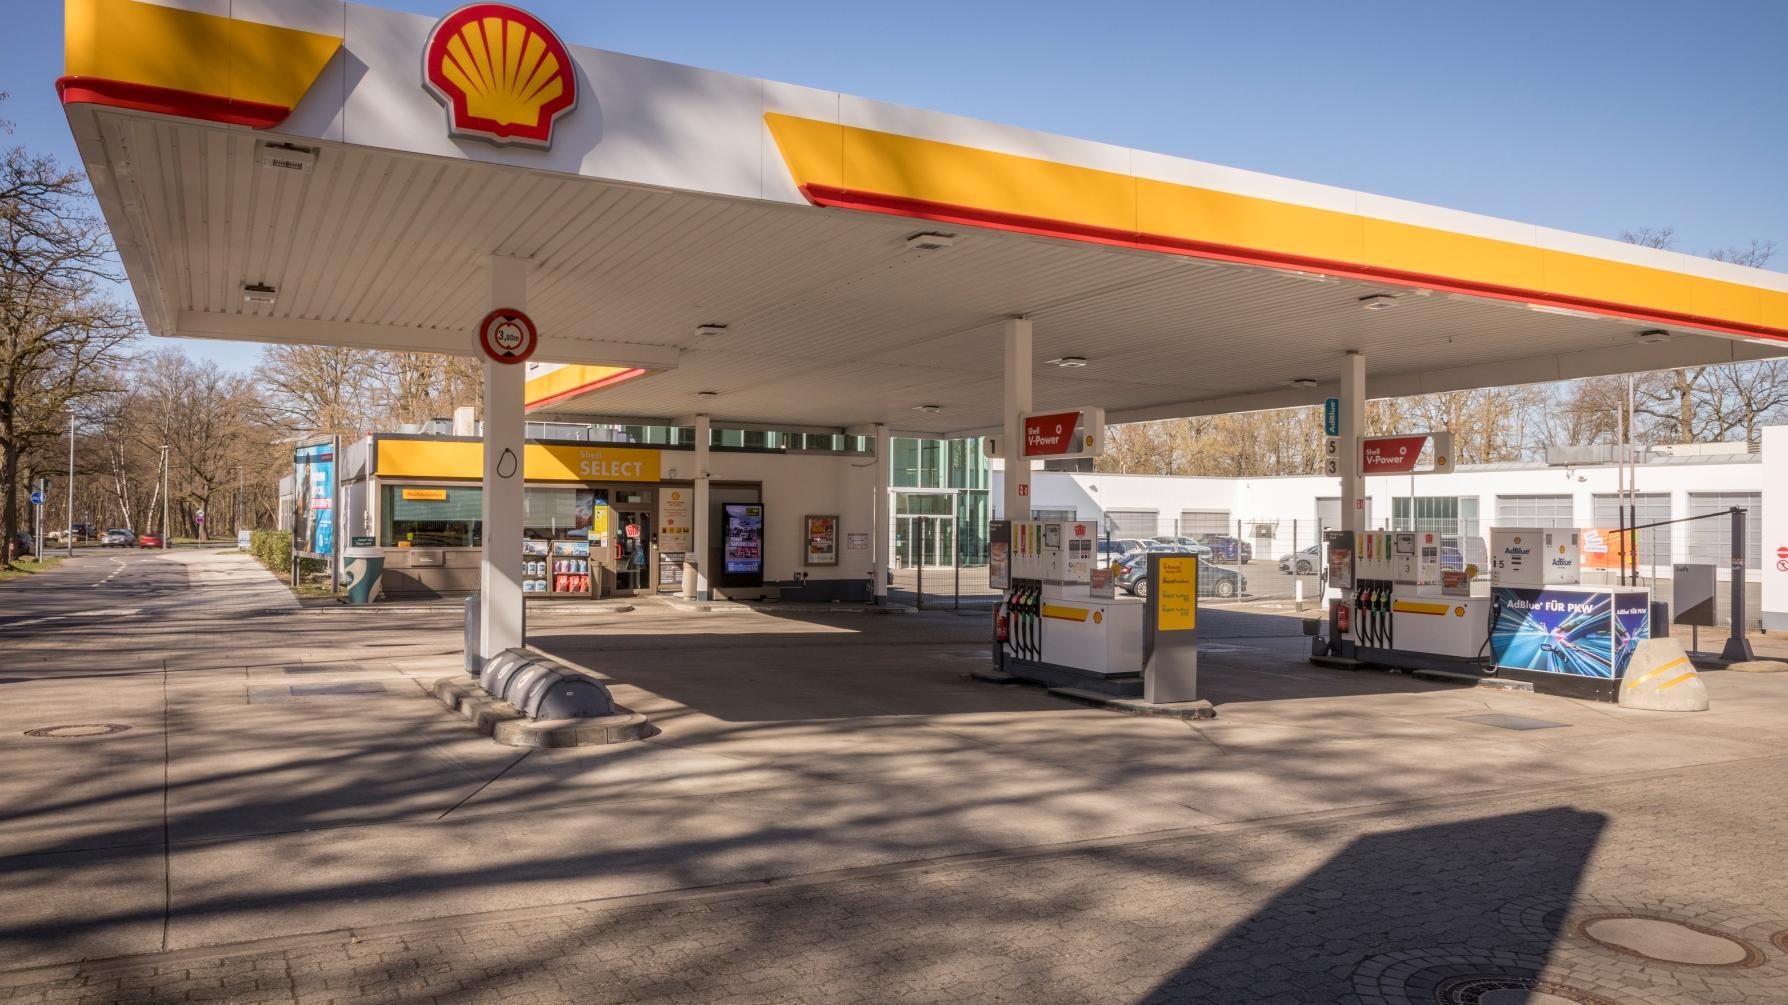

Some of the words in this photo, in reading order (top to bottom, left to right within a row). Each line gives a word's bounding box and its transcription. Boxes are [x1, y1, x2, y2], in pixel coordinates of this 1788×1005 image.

[1027, 427, 1040, 435] Shell
[990, 439, 996, 454] 1
[1028, 435, 1060, 446] V-Power
[1328, 441, 1336, 454] 5
[1366, 448, 1380, 456] Shell
[1366, 455, 1404, 465] V-Power
[580, 461, 643, 477] SELECT
[1328, 461, 1336, 474] 3
[1404, 564, 1410, 573] 3
[1545, 601, 1565, 612] FÜR
[1567, 603, 1594, 614] PKW
